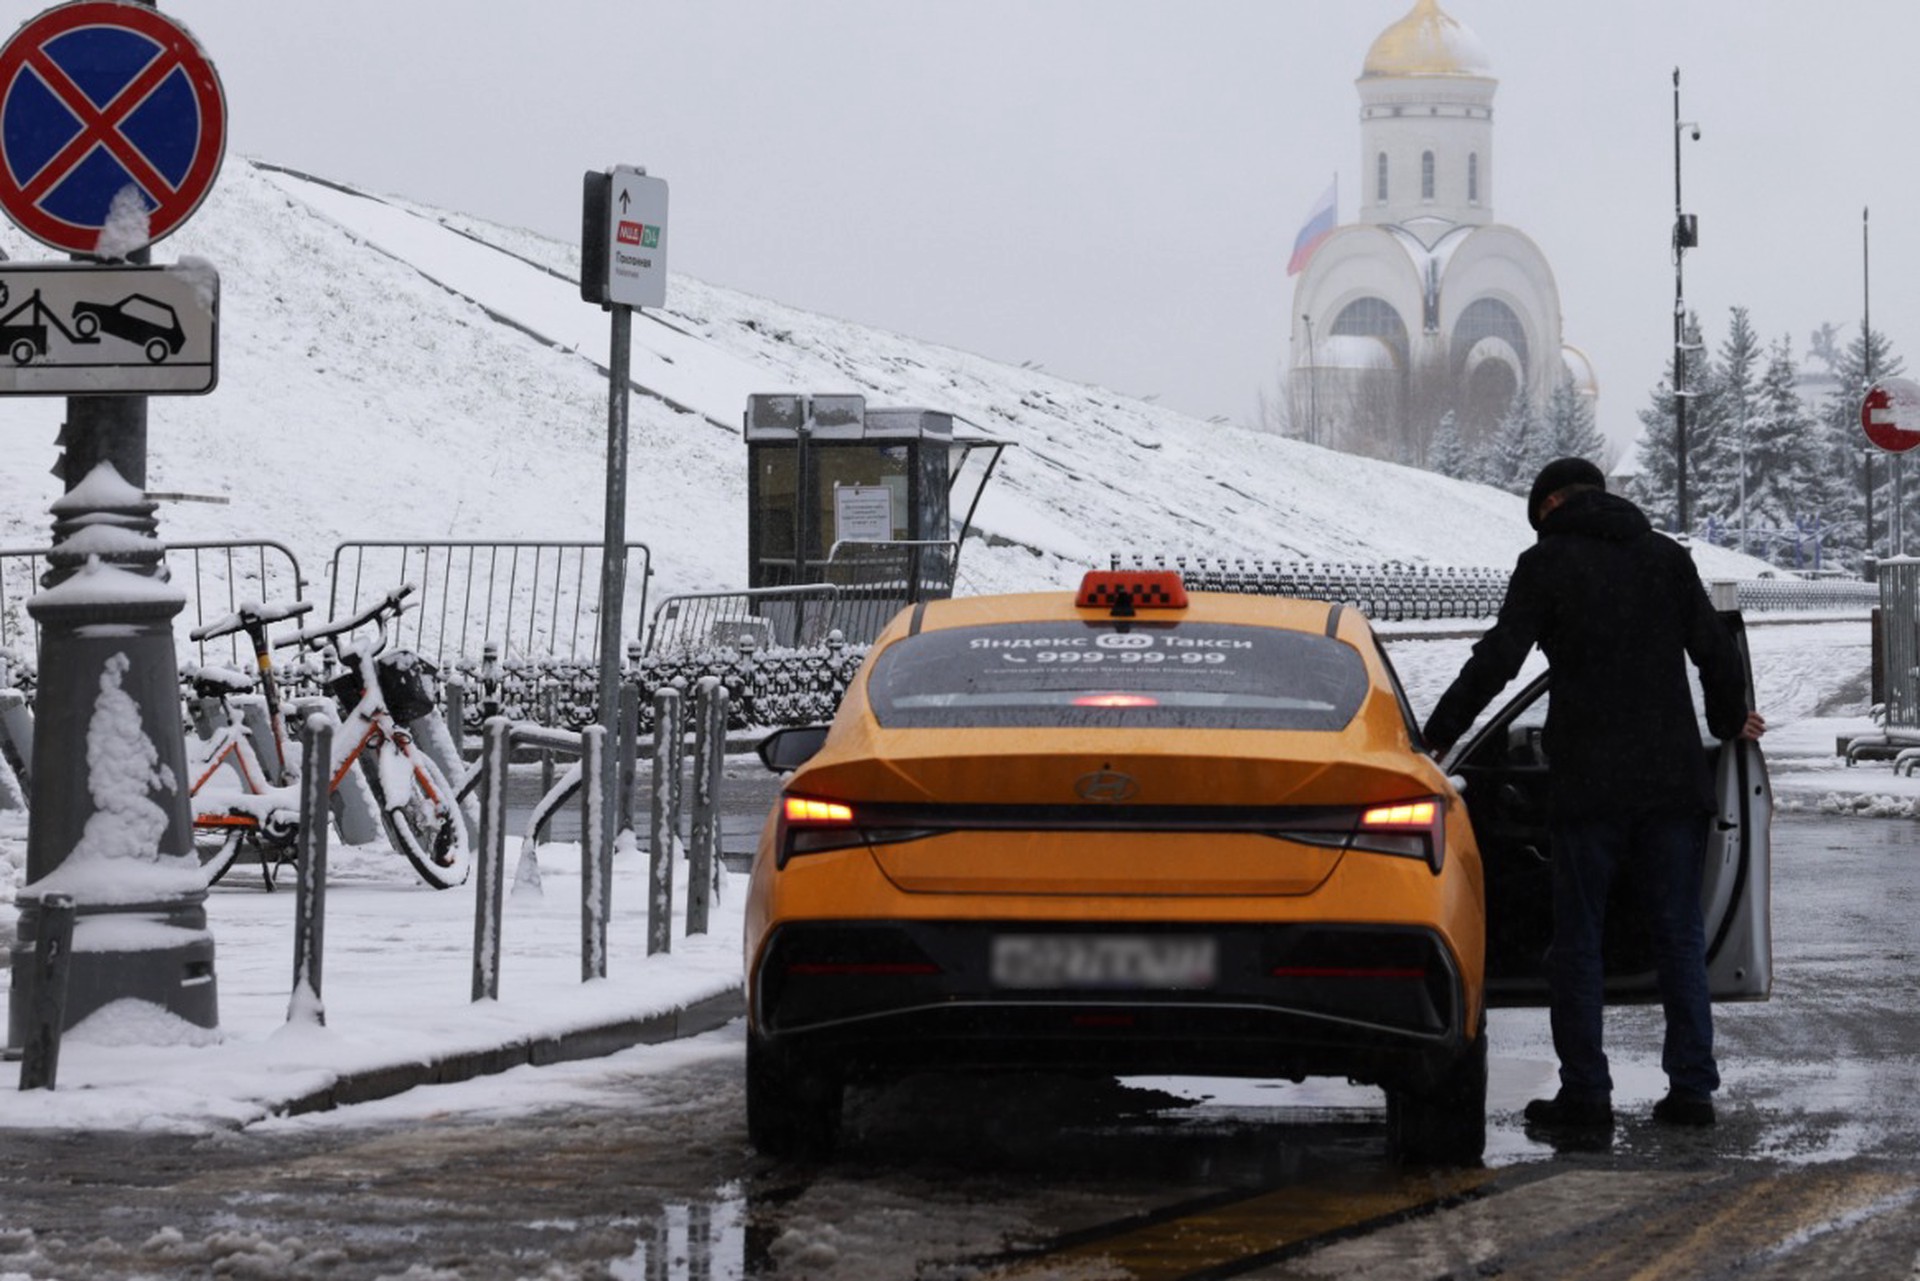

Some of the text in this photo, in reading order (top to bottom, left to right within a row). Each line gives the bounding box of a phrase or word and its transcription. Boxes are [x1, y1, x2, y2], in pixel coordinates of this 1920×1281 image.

[969, 637, 1089, 649] Яндекс
[1160, 636, 1253, 649] Такси
[1036, 651, 1226, 664] 999-99-99
